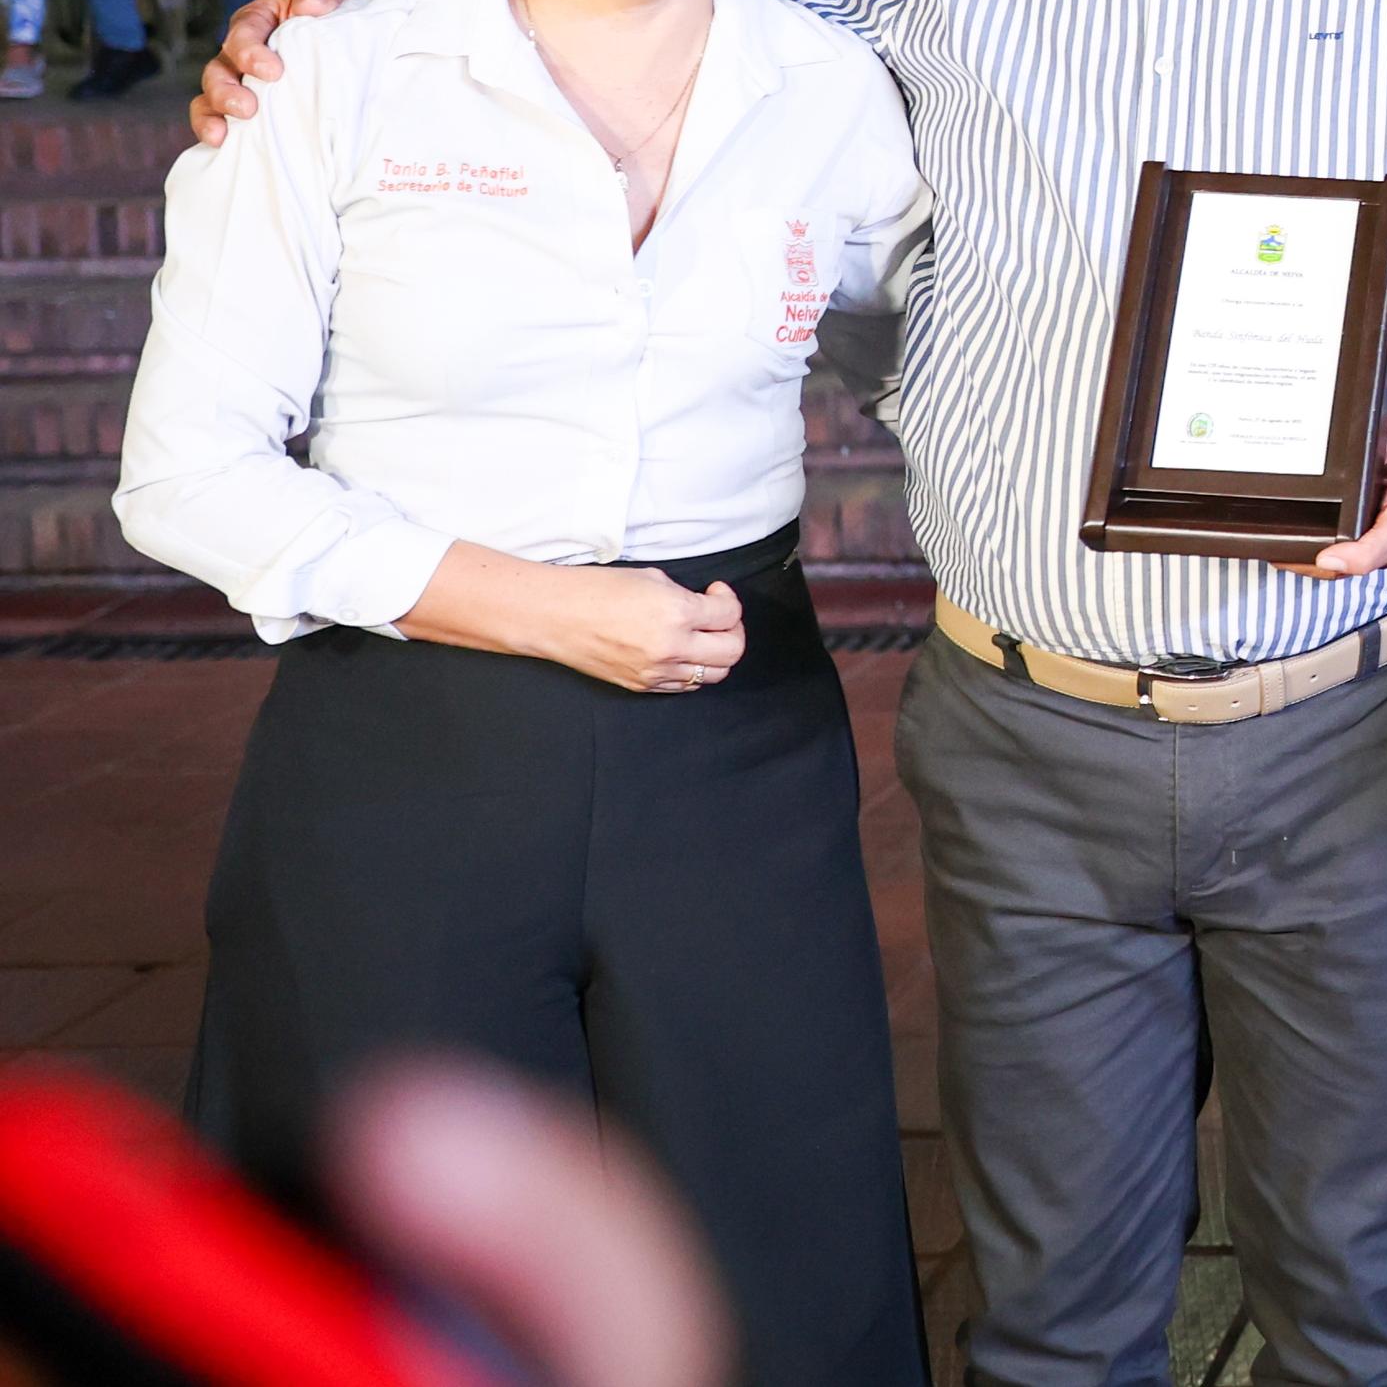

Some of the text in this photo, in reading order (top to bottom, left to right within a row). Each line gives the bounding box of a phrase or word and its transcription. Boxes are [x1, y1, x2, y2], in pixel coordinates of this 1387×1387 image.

[383, 158, 525, 181] Tania B. Peñafiel
[456, 179, 473, 193] de
[479, 181, 529, 197] Cultura
[780, 289, 817, 303] Alcaldía
